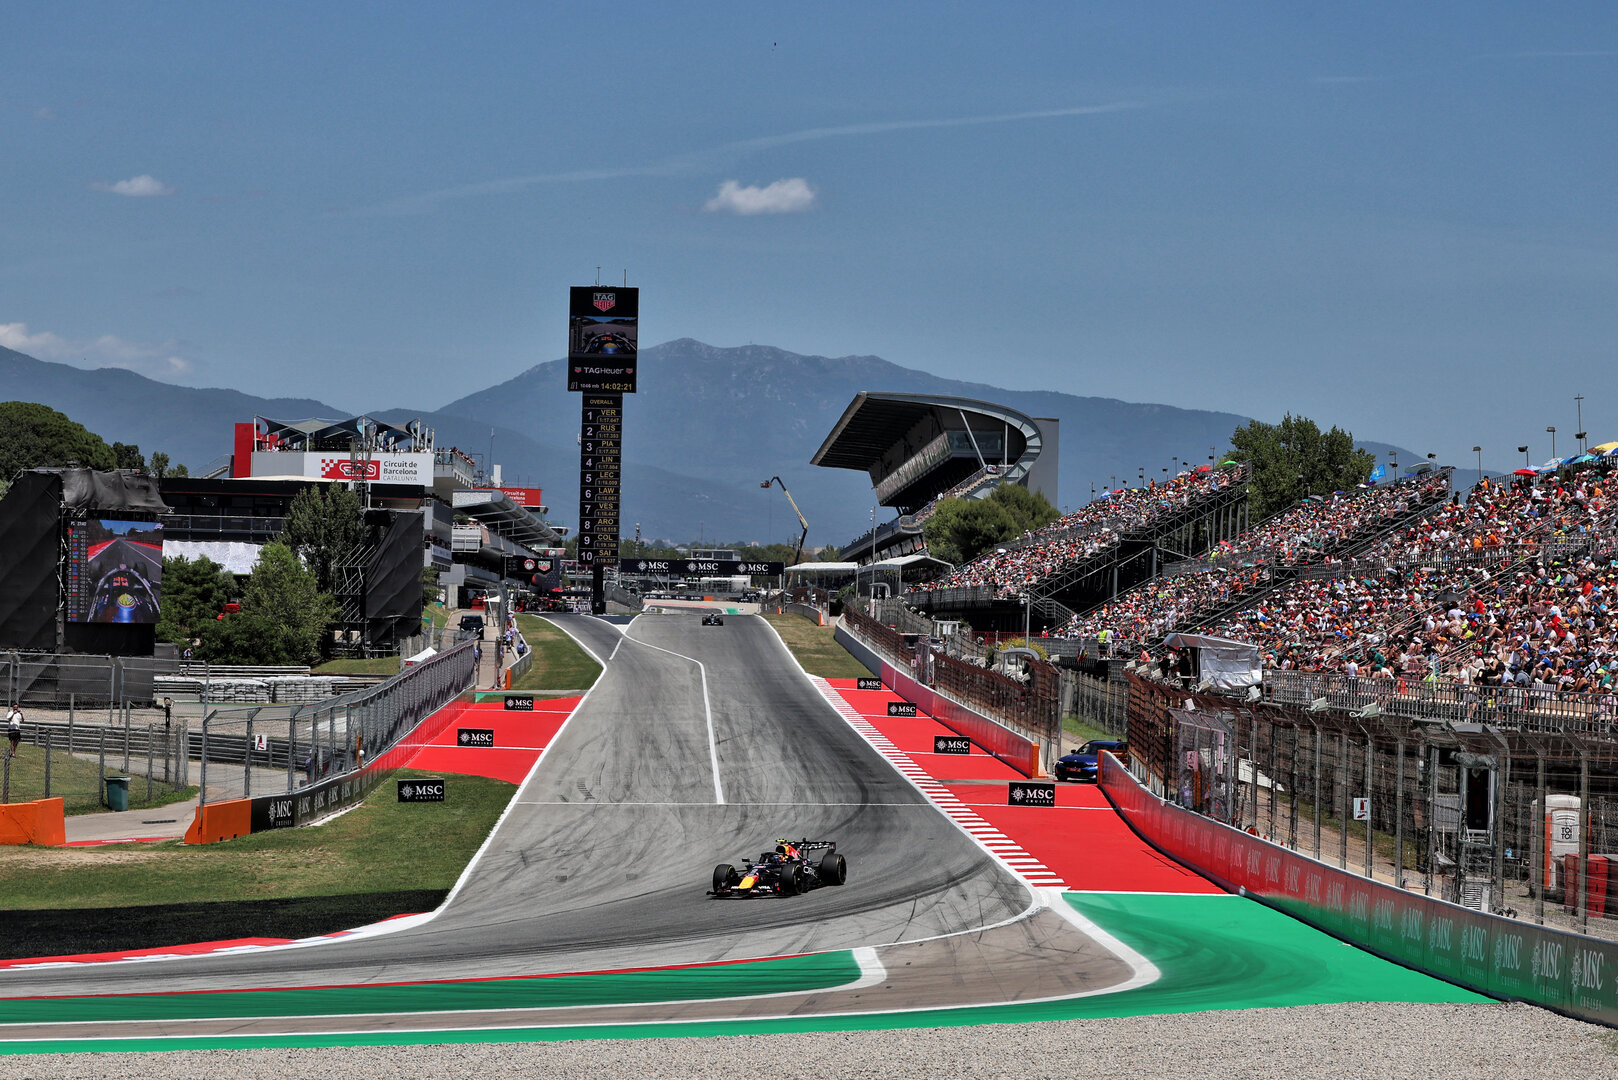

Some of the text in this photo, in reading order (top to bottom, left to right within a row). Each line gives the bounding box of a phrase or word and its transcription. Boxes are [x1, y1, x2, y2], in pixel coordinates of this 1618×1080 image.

[588, 412, 592, 420] 1
[587, 427, 592, 435] 2
[586, 443, 592, 451] 3
[586, 458, 592, 467] 4
[586, 474, 592, 482] 5
[585, 490, 591, 498] 6
[584, 505, 591, 513] 7
[584, 521, 590, 529] 8
[584, 536, 590, 544] 9
[581, 552, 592, 560] 10
[416, 786, 442, 795] MSC
[1026, 789, 1053, 799] MSC
[277, 800, 292, 818] MSC
[1380, 899, 1394, 931] MSC
[1407, 907, 1423, 941] MSC
[1436, 917, 1453, 951] MSC
[1468, 925, 1486, 961] MSC
[1502, 934, 1522, 970] MSC
[1541, 941, 1562, 980] MSC
[1582, 950, 1604, 990] MSC
